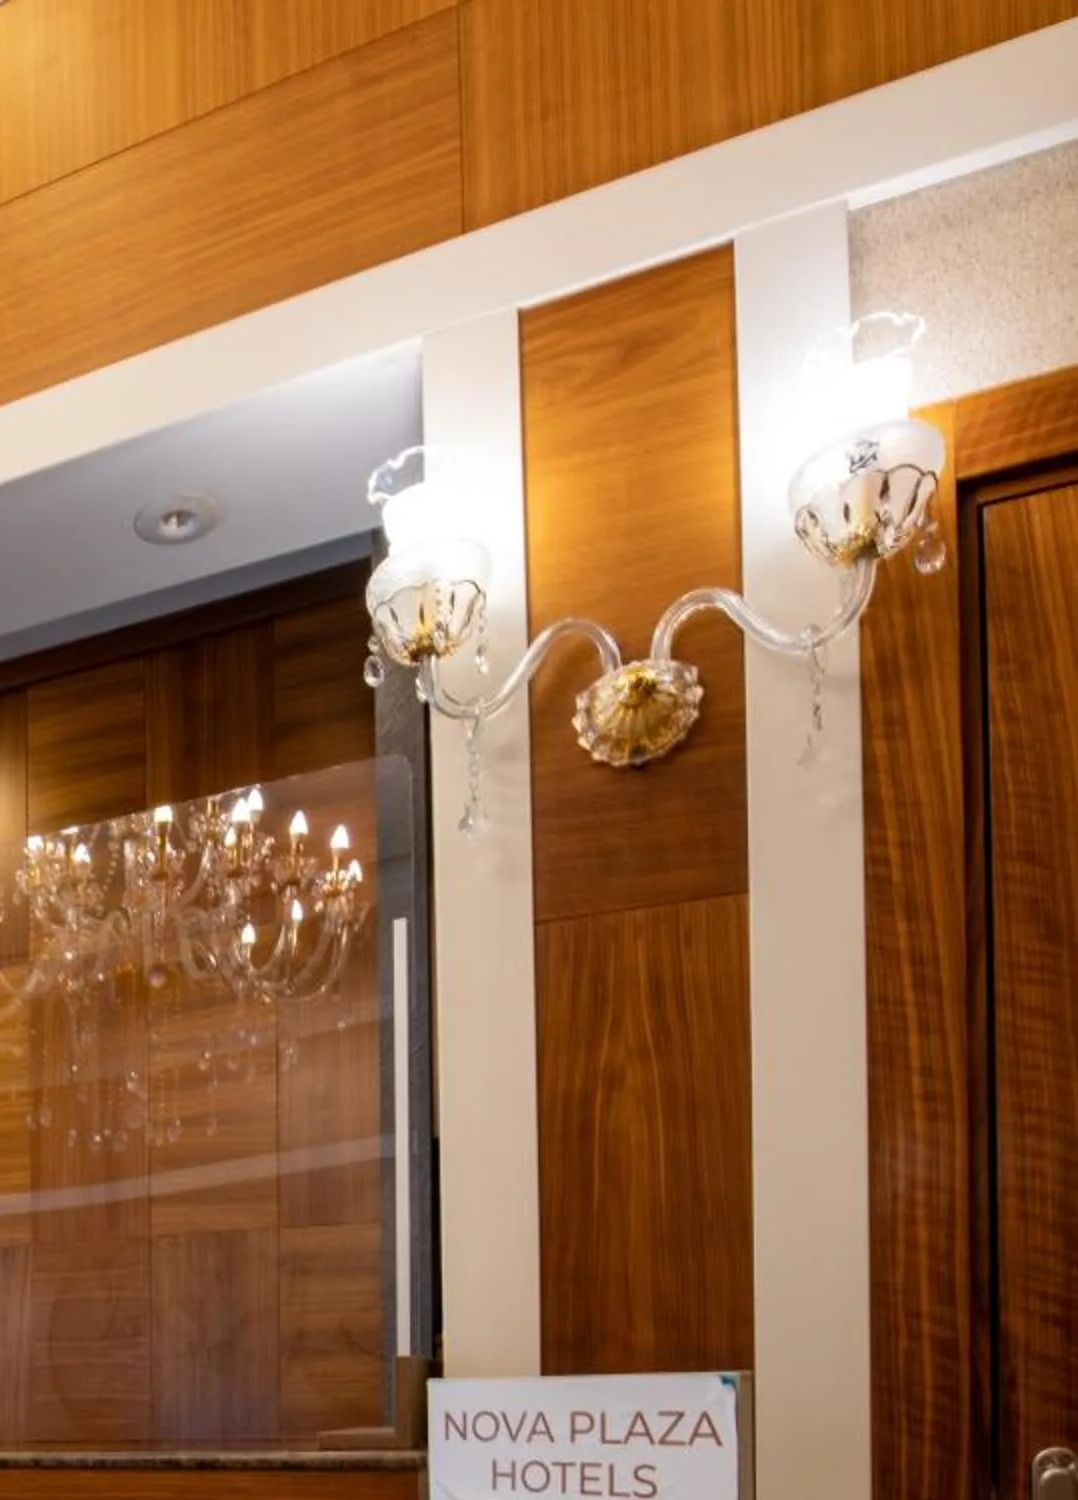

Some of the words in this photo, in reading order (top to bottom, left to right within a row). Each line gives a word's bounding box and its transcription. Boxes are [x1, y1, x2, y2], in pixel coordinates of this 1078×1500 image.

[443, 1410, 555, 1444] NOVA
[569, 1410, 723, 1447] PLAZA
[491, 1459, 658, 1500] HOTELS
